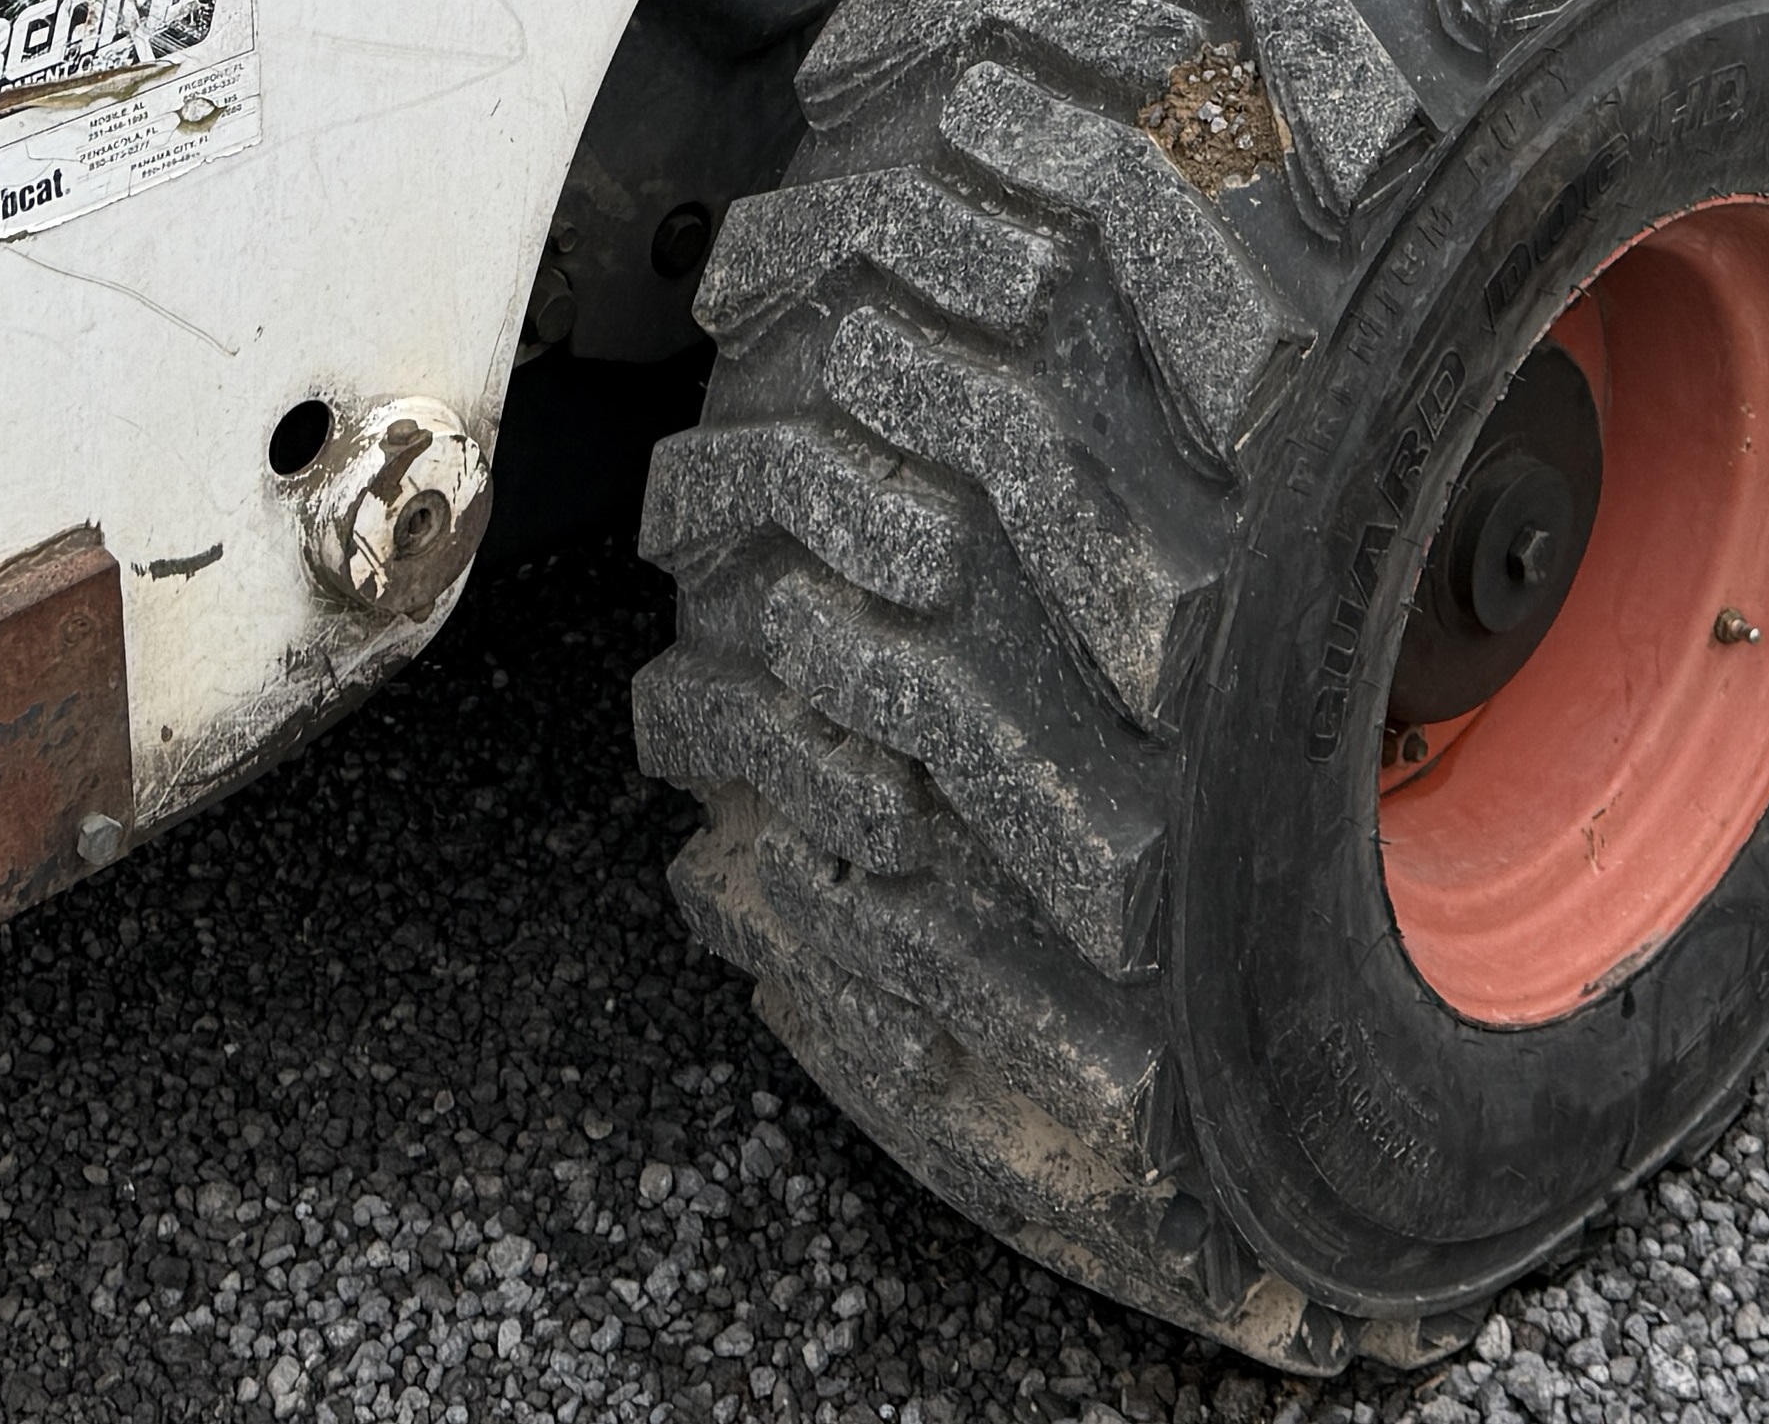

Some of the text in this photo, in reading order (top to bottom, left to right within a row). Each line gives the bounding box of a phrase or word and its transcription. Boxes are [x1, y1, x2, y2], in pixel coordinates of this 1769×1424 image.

[1305, 60, 1750, 763] GUARD DOG HD
